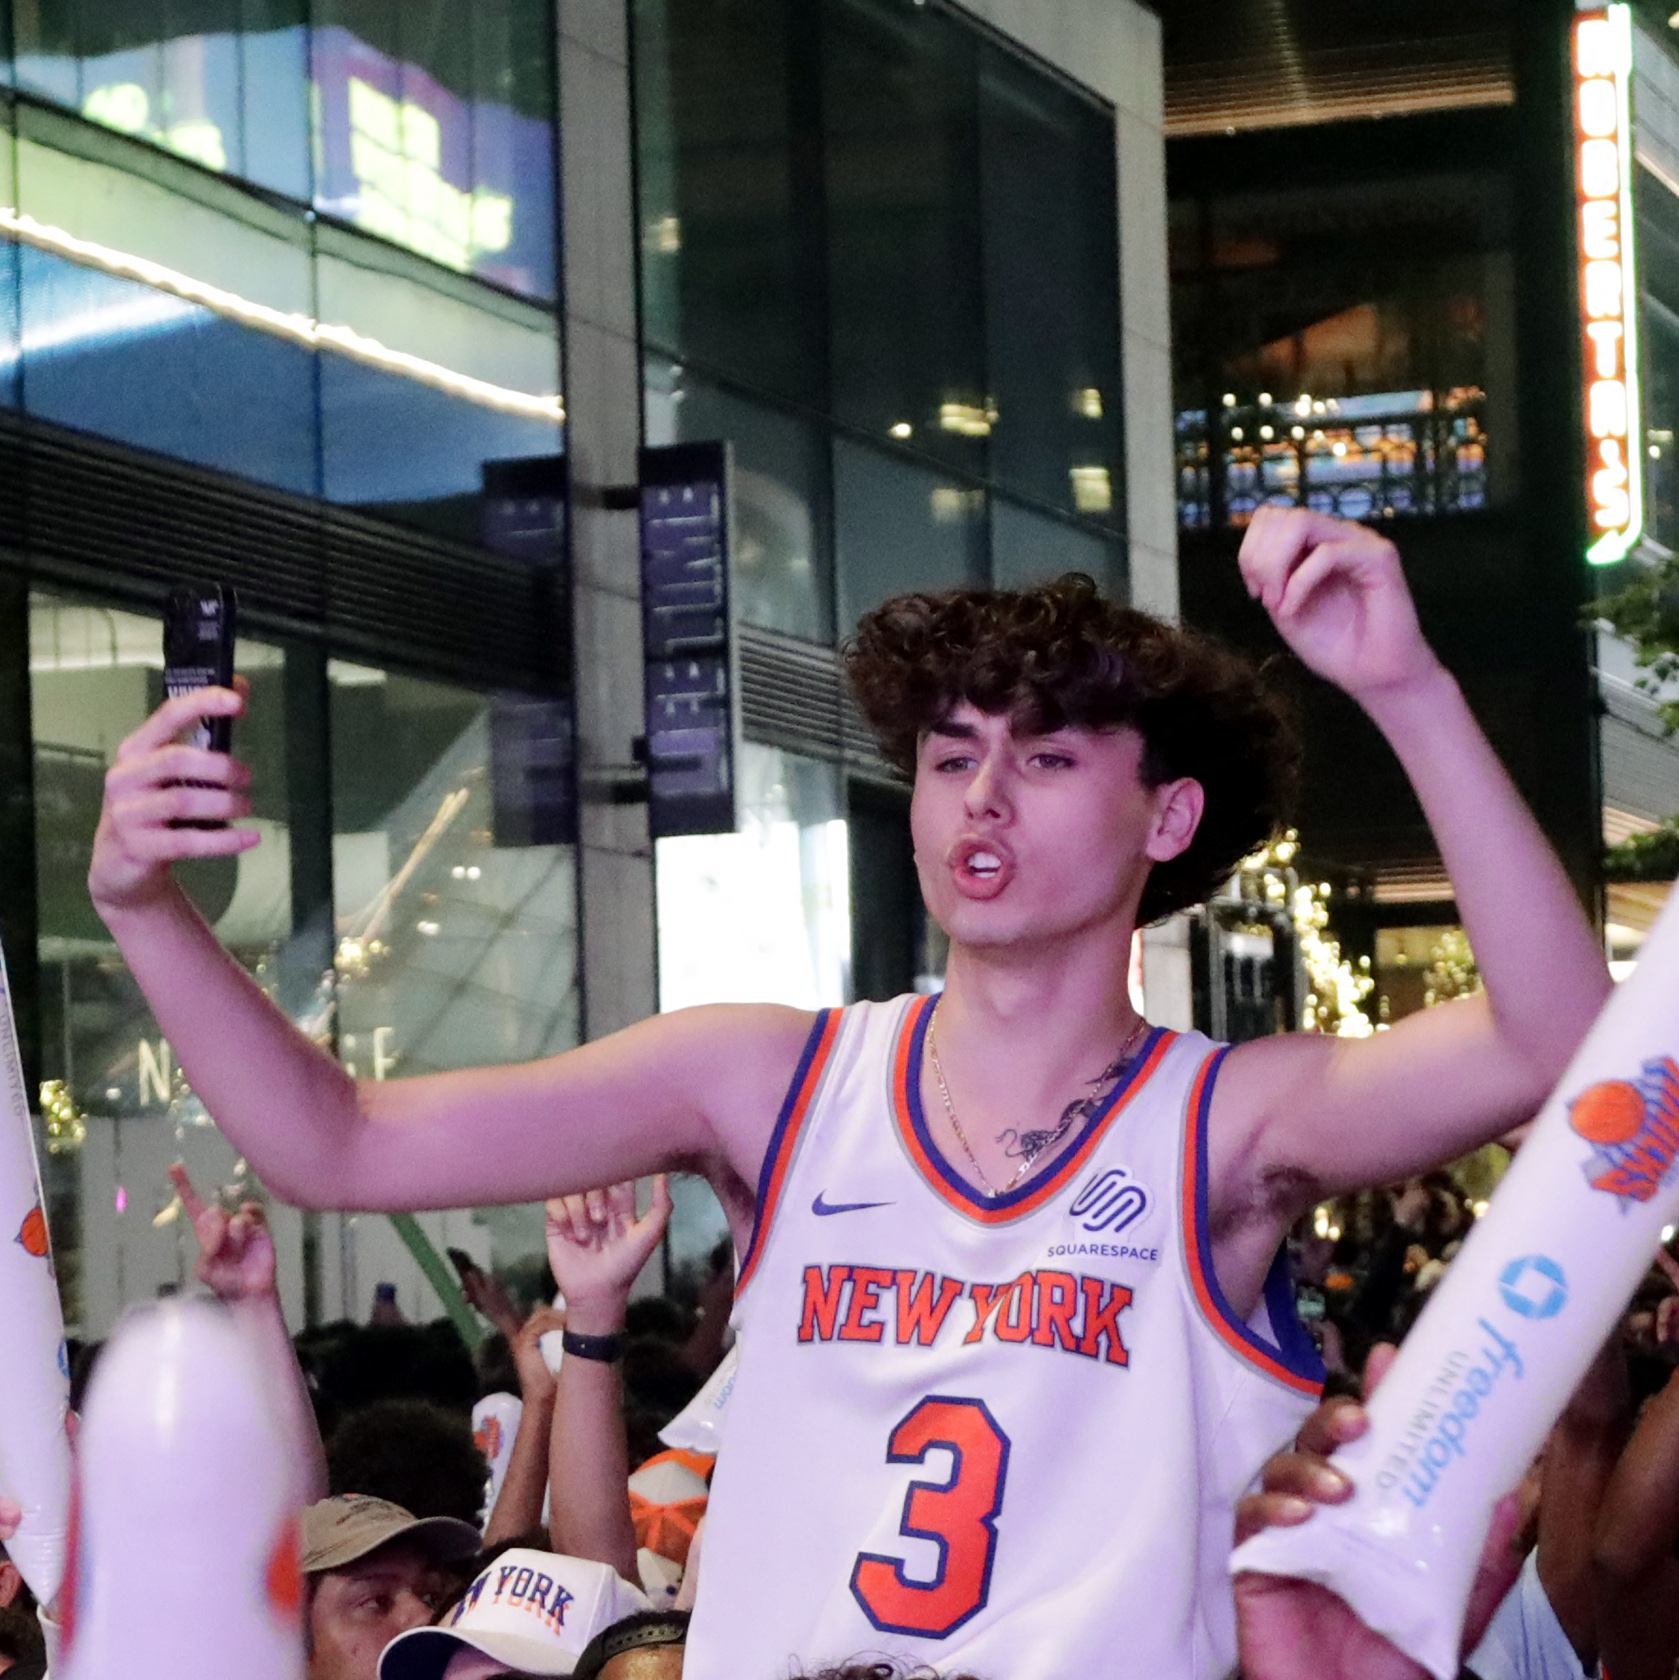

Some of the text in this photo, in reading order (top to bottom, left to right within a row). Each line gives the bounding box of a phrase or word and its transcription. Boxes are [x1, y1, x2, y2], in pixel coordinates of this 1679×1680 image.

[1047, 1243, 1159, 1262] SQUARESPACE
[797, 1264, 1134, 1369] NEW YORK
[1400, 1317, 1525, 1508] freedom
[849, 1396, 1012, 1639] 3
[492, 1566, 574, 1632] YORK
